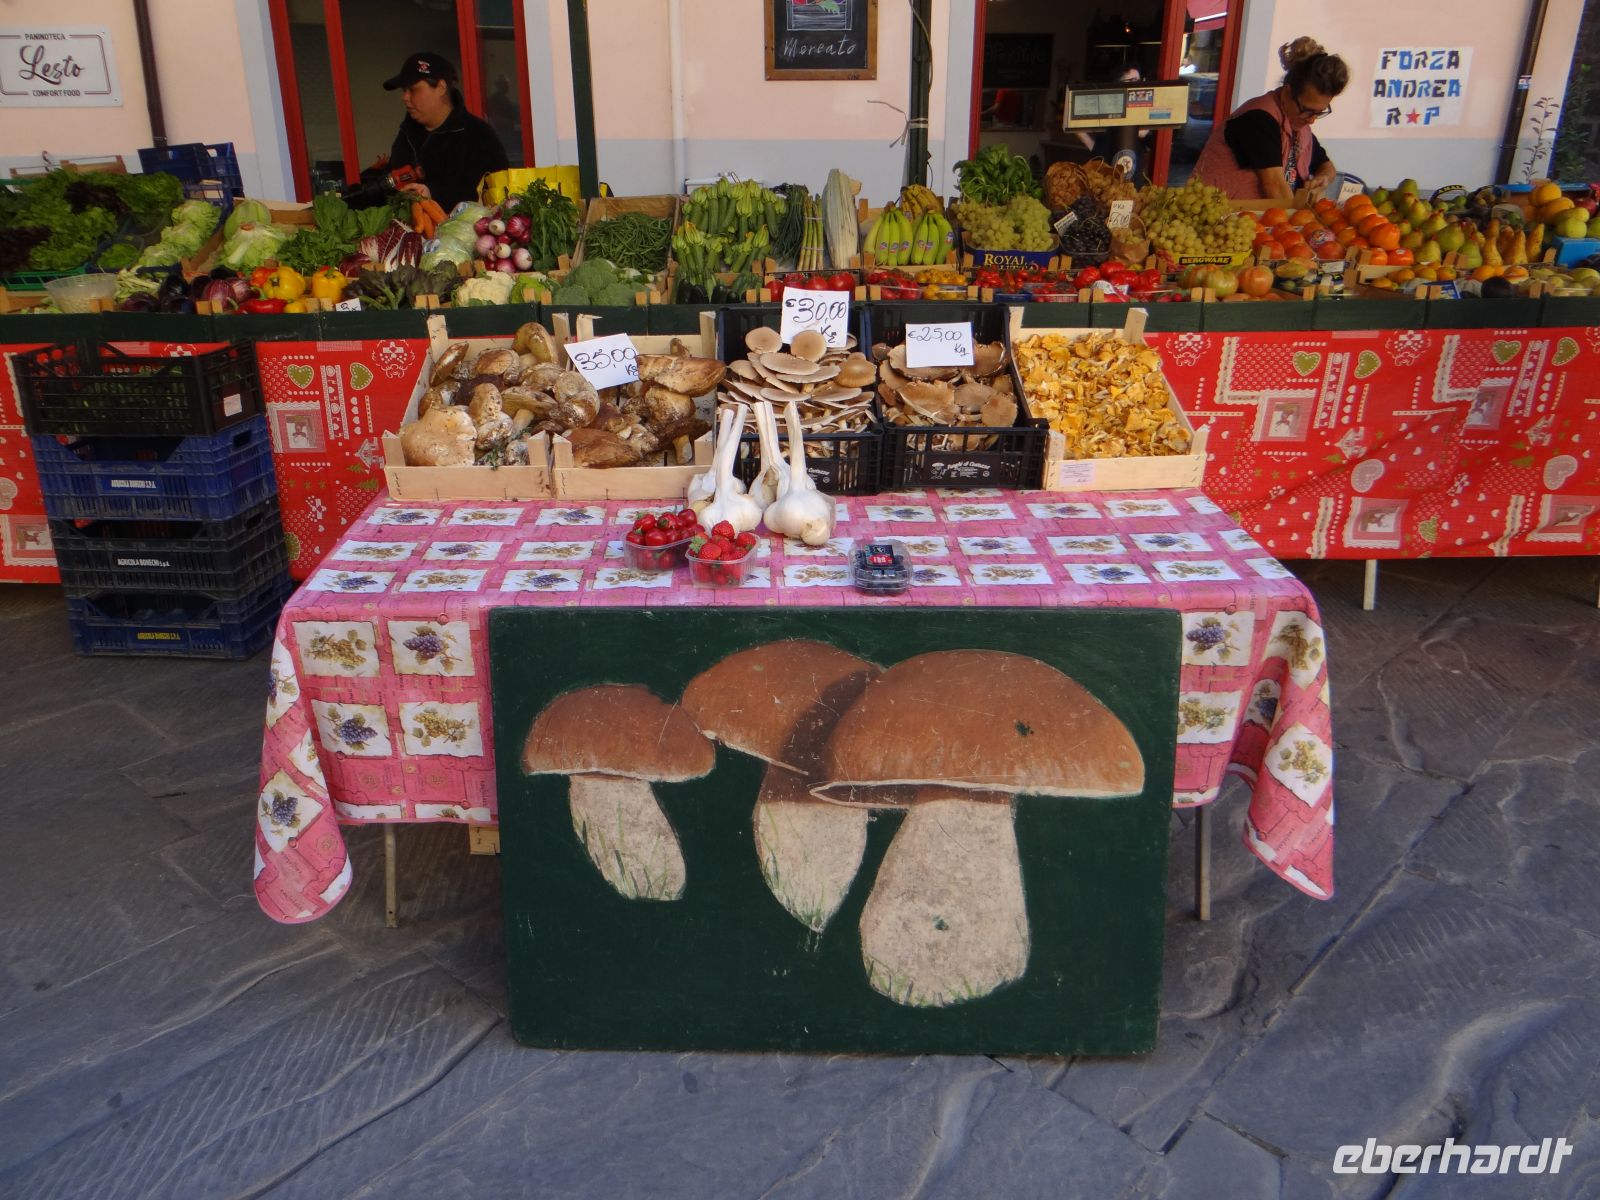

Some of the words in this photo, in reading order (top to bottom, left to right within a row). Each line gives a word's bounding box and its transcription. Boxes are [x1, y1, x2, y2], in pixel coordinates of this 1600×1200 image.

[19, 44, 84, 85] Lesto
[1381, 50, 1460, 70] FORZA
[33, 89, 62, 97] COMFORT
[63, 89, 81, 97] FOOD
[1373, 79, 1461, 98] ANDREA
[984, 253, 1027, 266] ROYAL
[1180, 256, 1231, 265] BERGWARE
[907, 326, 962, 342] €25,00
[574, 347, 637, 371] 35,00
